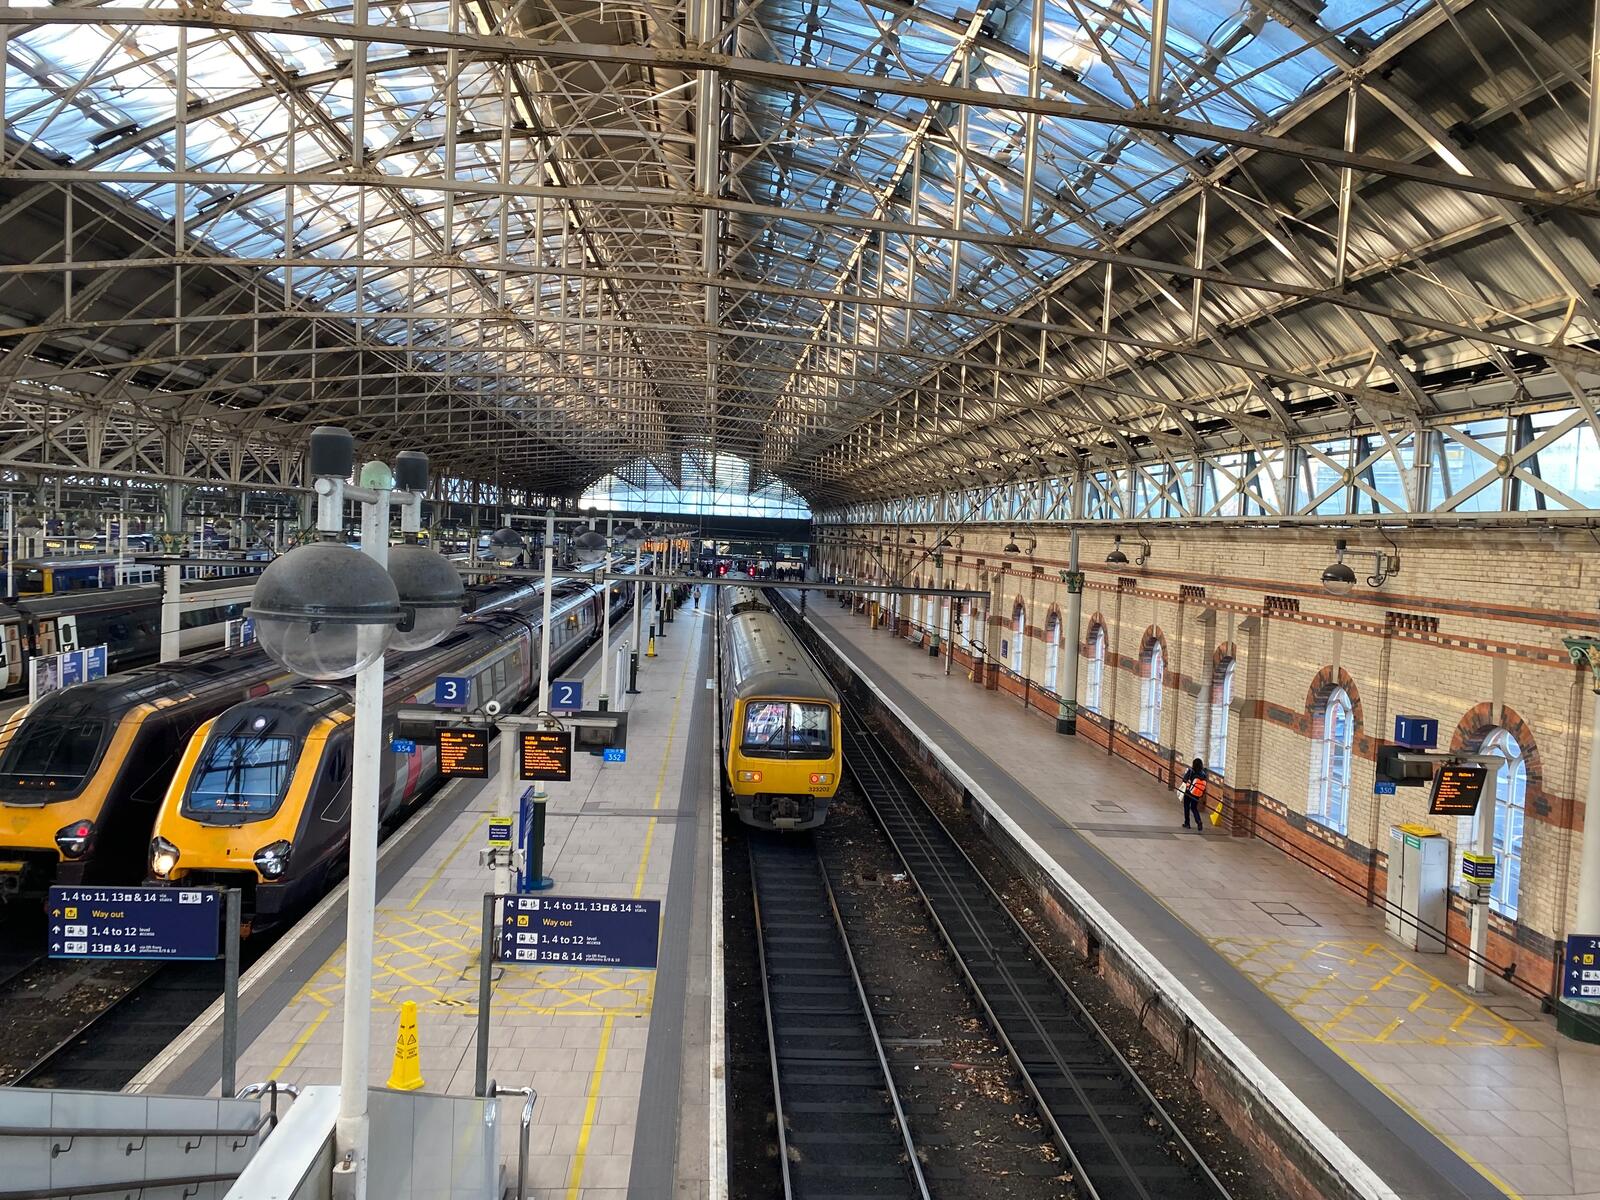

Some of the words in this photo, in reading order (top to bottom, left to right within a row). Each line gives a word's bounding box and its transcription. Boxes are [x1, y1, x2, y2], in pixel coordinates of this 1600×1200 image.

[444, 681, 457, 699] 3
[560, 686, 573, 704] 2
[1401, 721, 1406, 739] 1
[1421, 724, 1428, 741] 1
[61, 892, 70, 901] 1,
[72, 892, 79, 901] 4
[81, 893, 92, 901] to
[94, 893, 109, 902] 11,
[112, 893, 124, 902] 13
[134, 893, 141, 902] &
[144, 893, 157, 902] 14
[543, 901, 551, 910] 1,
[553, 901, 560, 909] 4
[562, 902, 572, 910] to
[574, 902, 588, 911] 11,
[590, 902, 601, 911] 13
[611, 903, 618, 912] &
[620, 904, 632, 912] 14
[92, 910, 109, 919] Way
[542, 918, 559, 927] Way
[91, 926, 101, 936] 1,
[102, 926, 109, 935] 4
[111, 928, 122, 936] to
[124, 927, 137, 936] 12
[541, 935, 550, 944] 1,
[551, 935, 558, 943] 4
[560, 936, 570, 944] to
[572, 936, 584, 945] 12
[1590, 940, 1597, 949] 2
[91, 944, 103, 952] 13
[113, 944, 121, 953] &
[123, 944, 136, 953] 14
[541, 951, 552, 960] 13
[561, 952, 569, 961] &
[571, 952, 583, 961] 14
